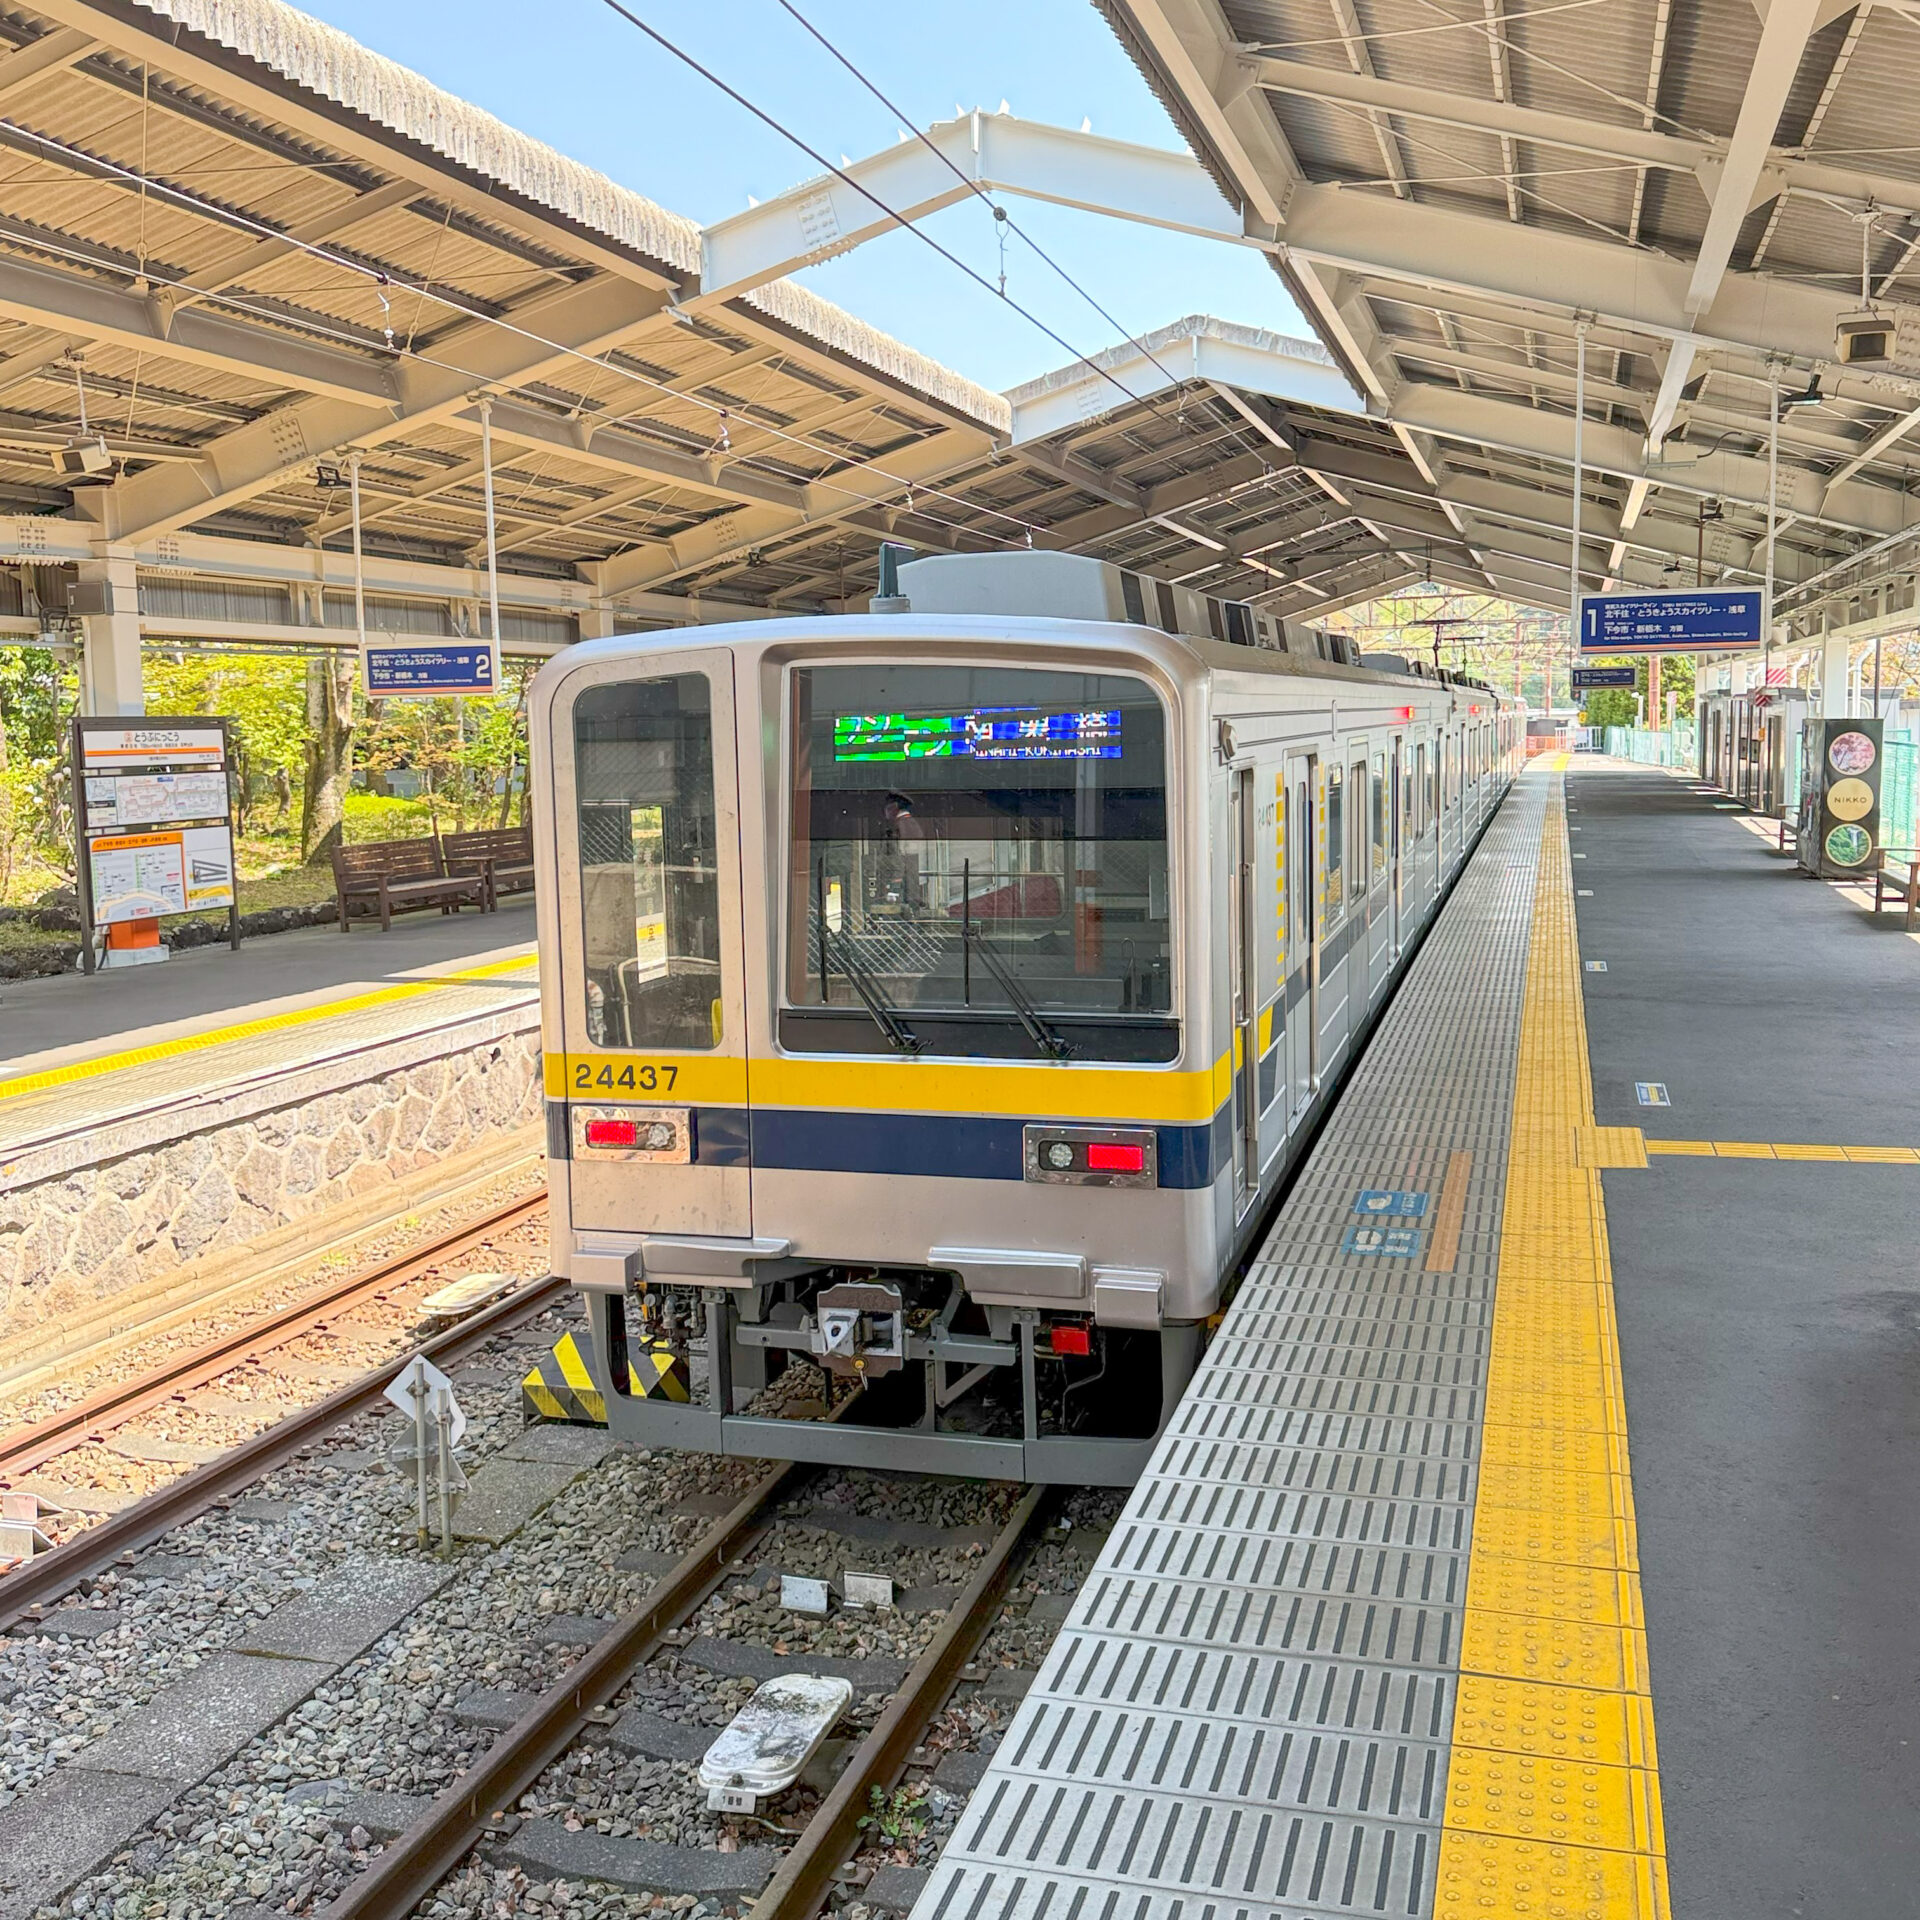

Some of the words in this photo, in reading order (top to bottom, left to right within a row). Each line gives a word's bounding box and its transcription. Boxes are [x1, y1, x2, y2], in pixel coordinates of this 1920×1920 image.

[1587, 609, 1597, 636] 1
[475, 654, 490, 679] 2
[134, 731, 180, 743] とうぶにっこう
[1834, 796, 1867, 804] NIKKO
[575, 1063, 678, 1092] 24437
